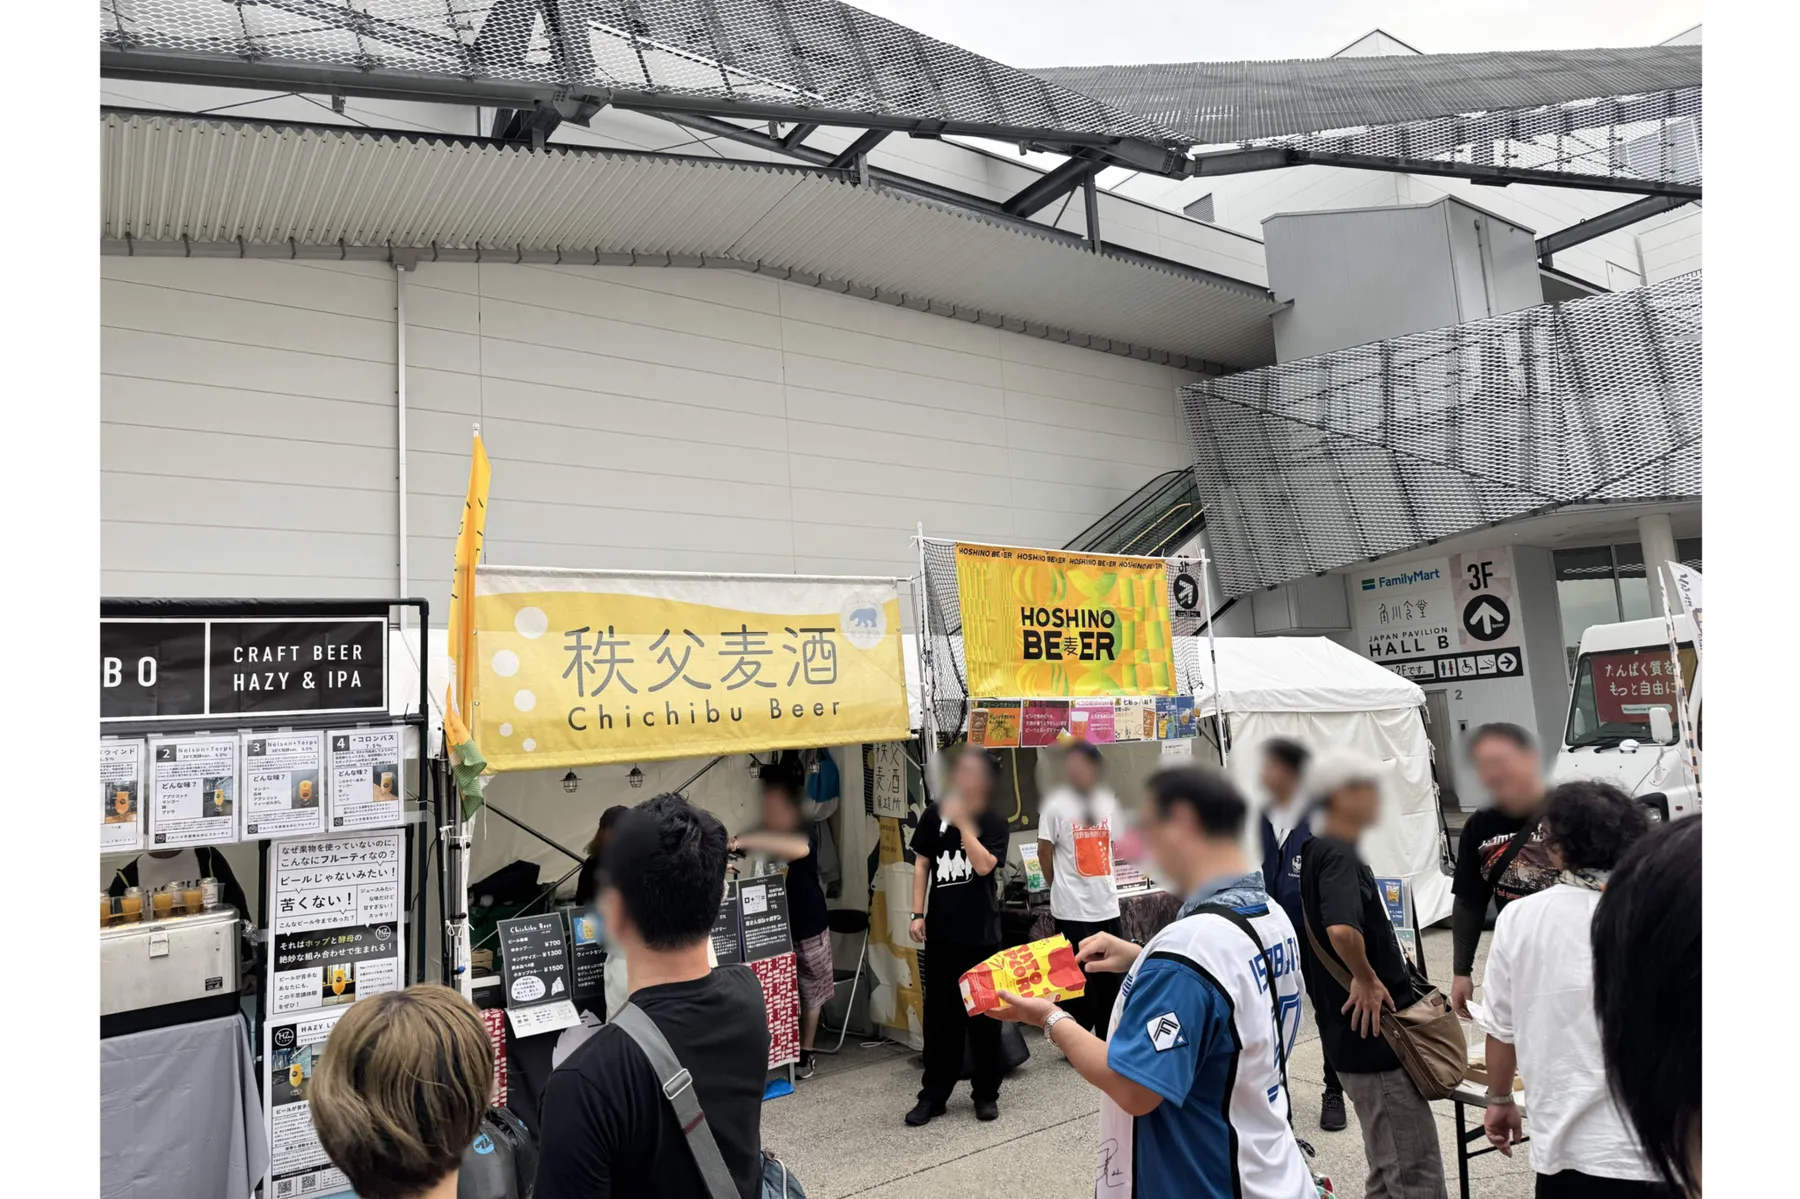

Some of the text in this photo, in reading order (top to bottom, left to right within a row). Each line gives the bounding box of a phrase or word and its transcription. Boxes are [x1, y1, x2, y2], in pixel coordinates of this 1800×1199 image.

[1378, 568, 1440, 588] FamilyMart
[1468, 561, 1493, 590] 3F
[1020, 606, 1116, 628] HOSHINO
[1368, 626, 1448, 642] JAPAN PAVILION
[233, 644, 363, 663] CRAFT BEER
[1369, 636, 1450, 657] HALL B
[562, 624, 838, 698] 秩父麦酒
[1606, 661, 1674, 676] たんぱく質を
[1390, 664, 1426, 676] 2Fです。
[233, 670, 362, 692] HAZY & IPA
[1610, 680, 1676, 696] もっと自由に
[1454, 690, 1463, 700] 2
[568, 698, 840, 731] Chichibu Beer
[253, 742, 260, 752] 3
[336, 738, 346, 748] 4
[162, 748, 170, 758] 2
[282, 840, 396, 855] なぜ果物を使っていないのに、
[281, 850, 395, 868] こんなにフルーティなの?
[280, 867, 396, 886] ビールじゃないみたい!
[280, 892, 352, 912] 苦くない!
[279, 915, 354, 928] こんなビール今まであった?
[280, 934, 362, 950] それはホップと酵母の
[544, 940, 561, 948] ¥700
[279, 943, 392, 964] 絶妙な組み合わせで生まれる!
[542, 949, 562, 958] ¥1300
[544, 964, 564, 972] ¥1500
[301, 1024, 323, 1032] HAZY
